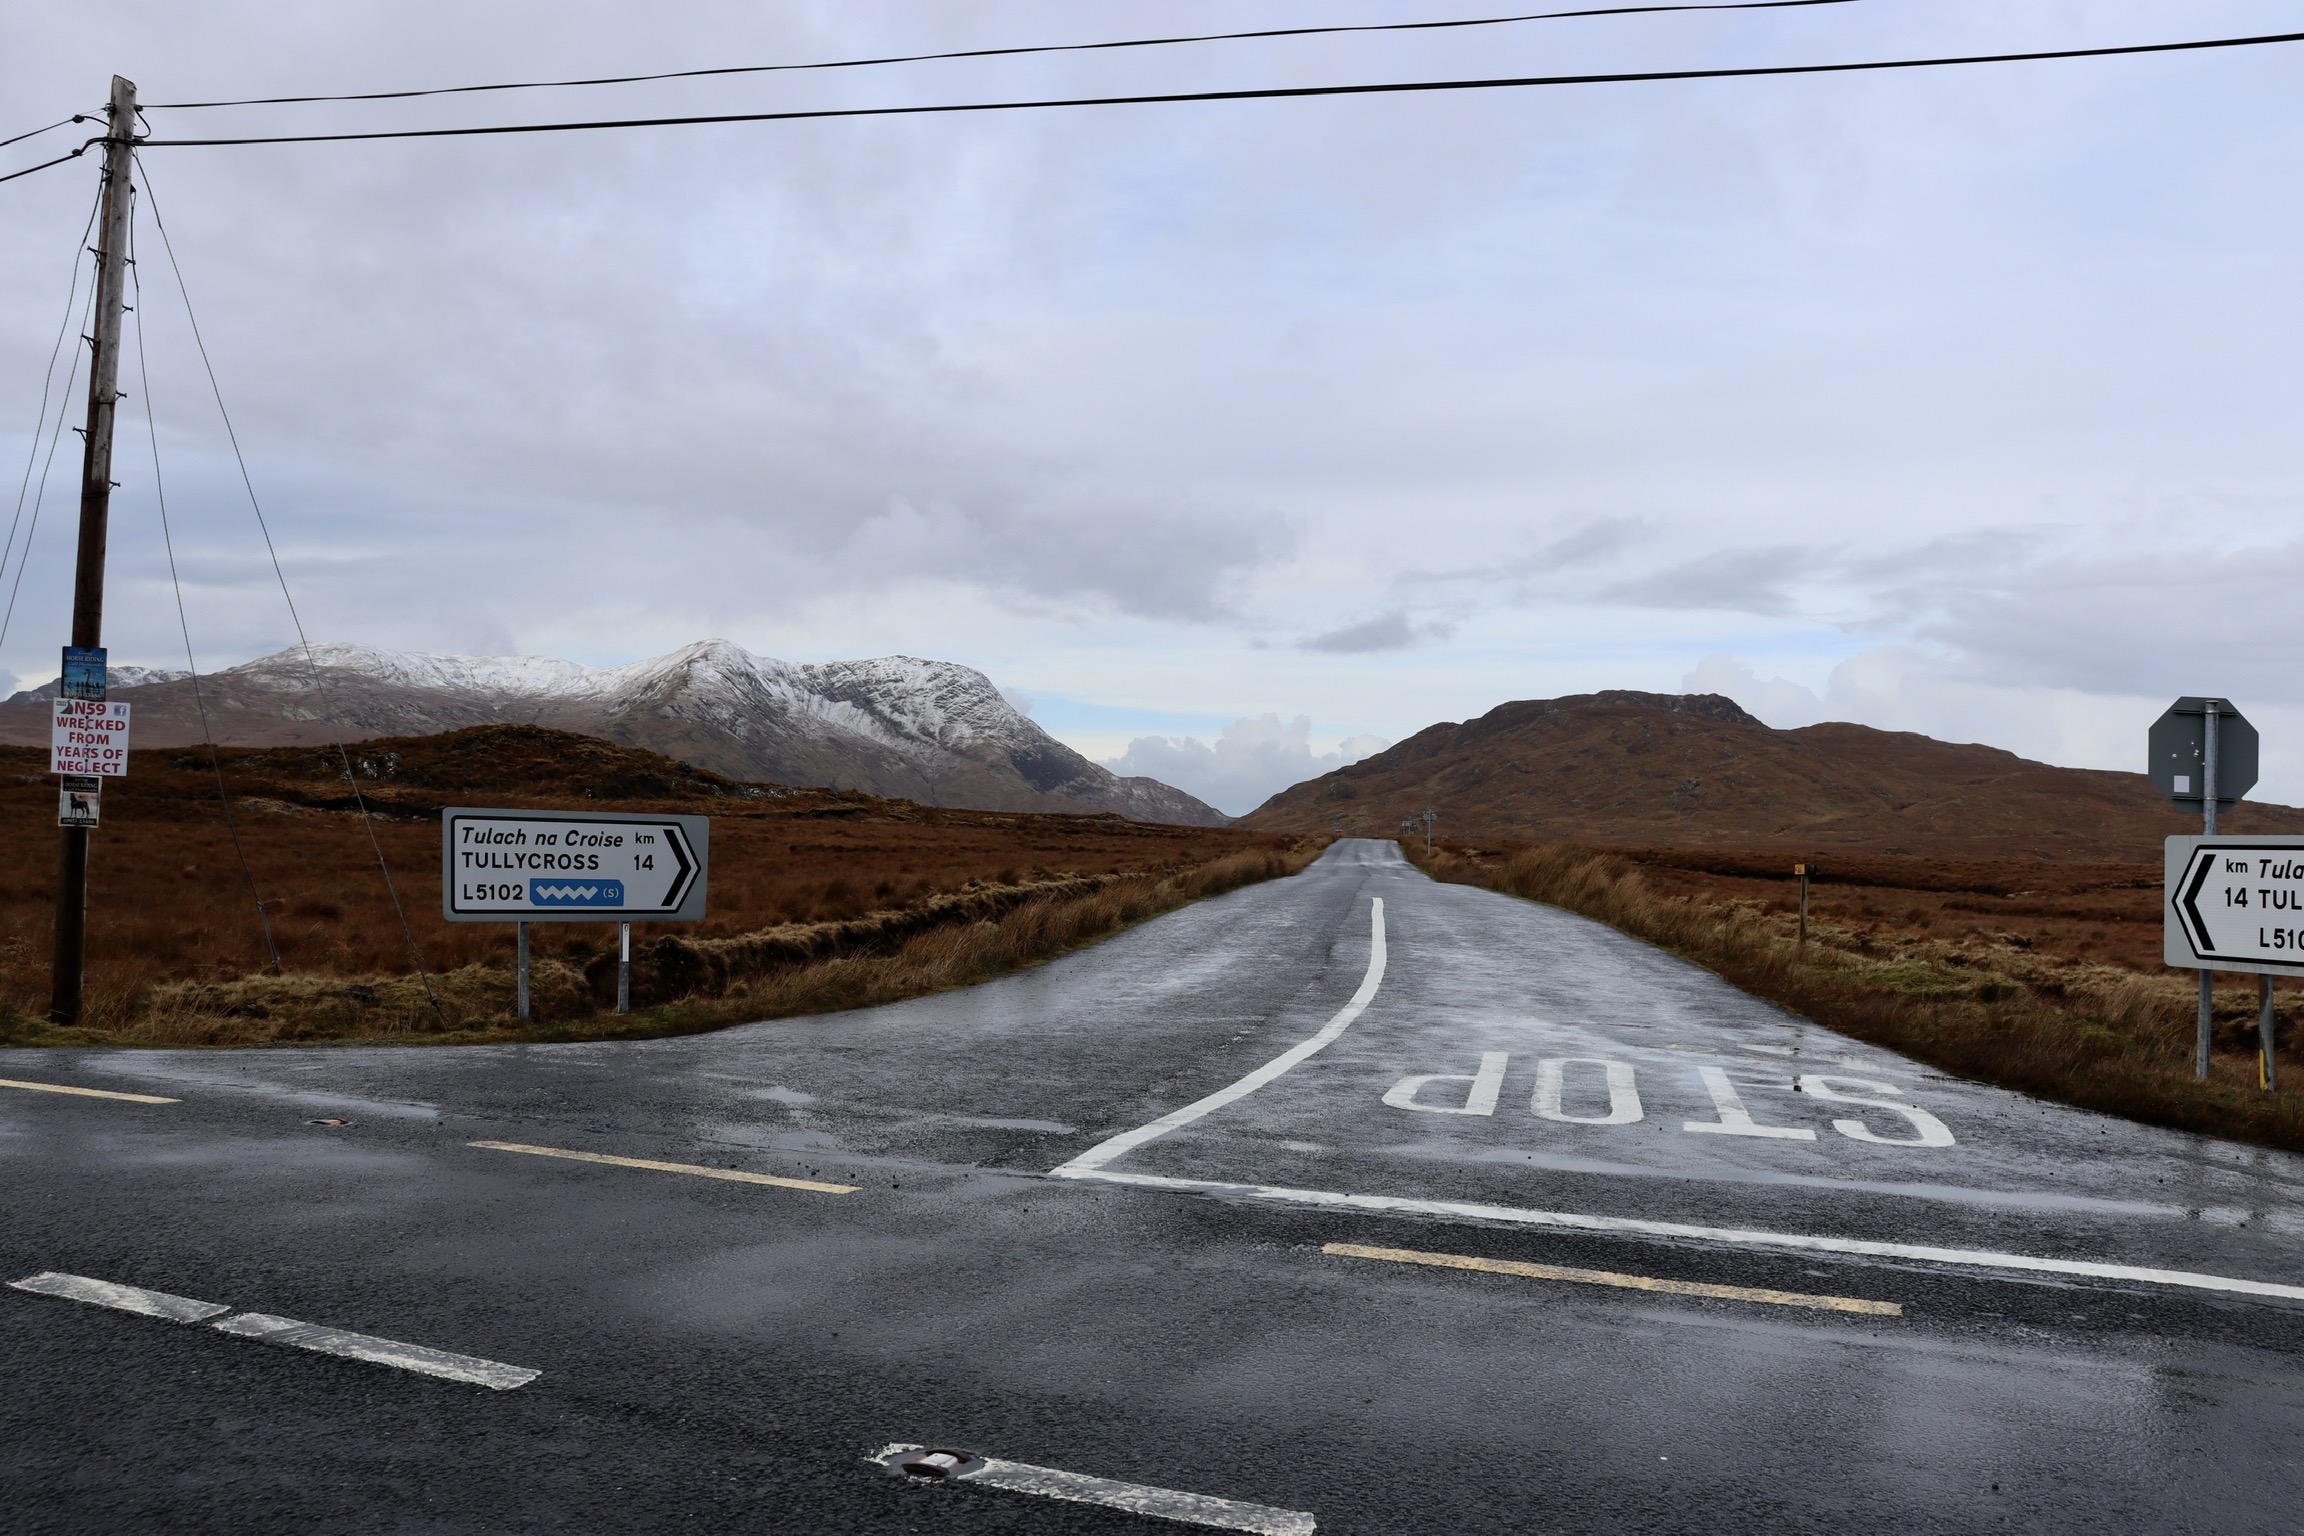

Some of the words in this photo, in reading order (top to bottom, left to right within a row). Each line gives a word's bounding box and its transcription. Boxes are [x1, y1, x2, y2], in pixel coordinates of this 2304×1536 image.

[74, 701, 107, 716] N59
[56, 716, 126, 731] WRECKED
[68, 731, 110, 745] FROM
[56, 745, 99, 759] YEARS
[102, 748, 124, 760] OF
[57, 760, 121, 774] NEGLECT
[461, 827, 527, 846] Tulach
[534, 833, 558, 846] na
[564, 829, 624, 848] Croise
[634, 832, 655, 845] km
[461, 852, 600, 871] TULLYCROSS
[633, 854, 655, 871] 14
[2226, 858, 2249, 874] km
[2259, 859, 2304, 879] Tula
[463, 883, 524, 901] L5102
[2224, 887, 2249, 908] 14
[2258, 889, 2303, 911] TUL
[1382, 1051, 1957, 1148] STOP
